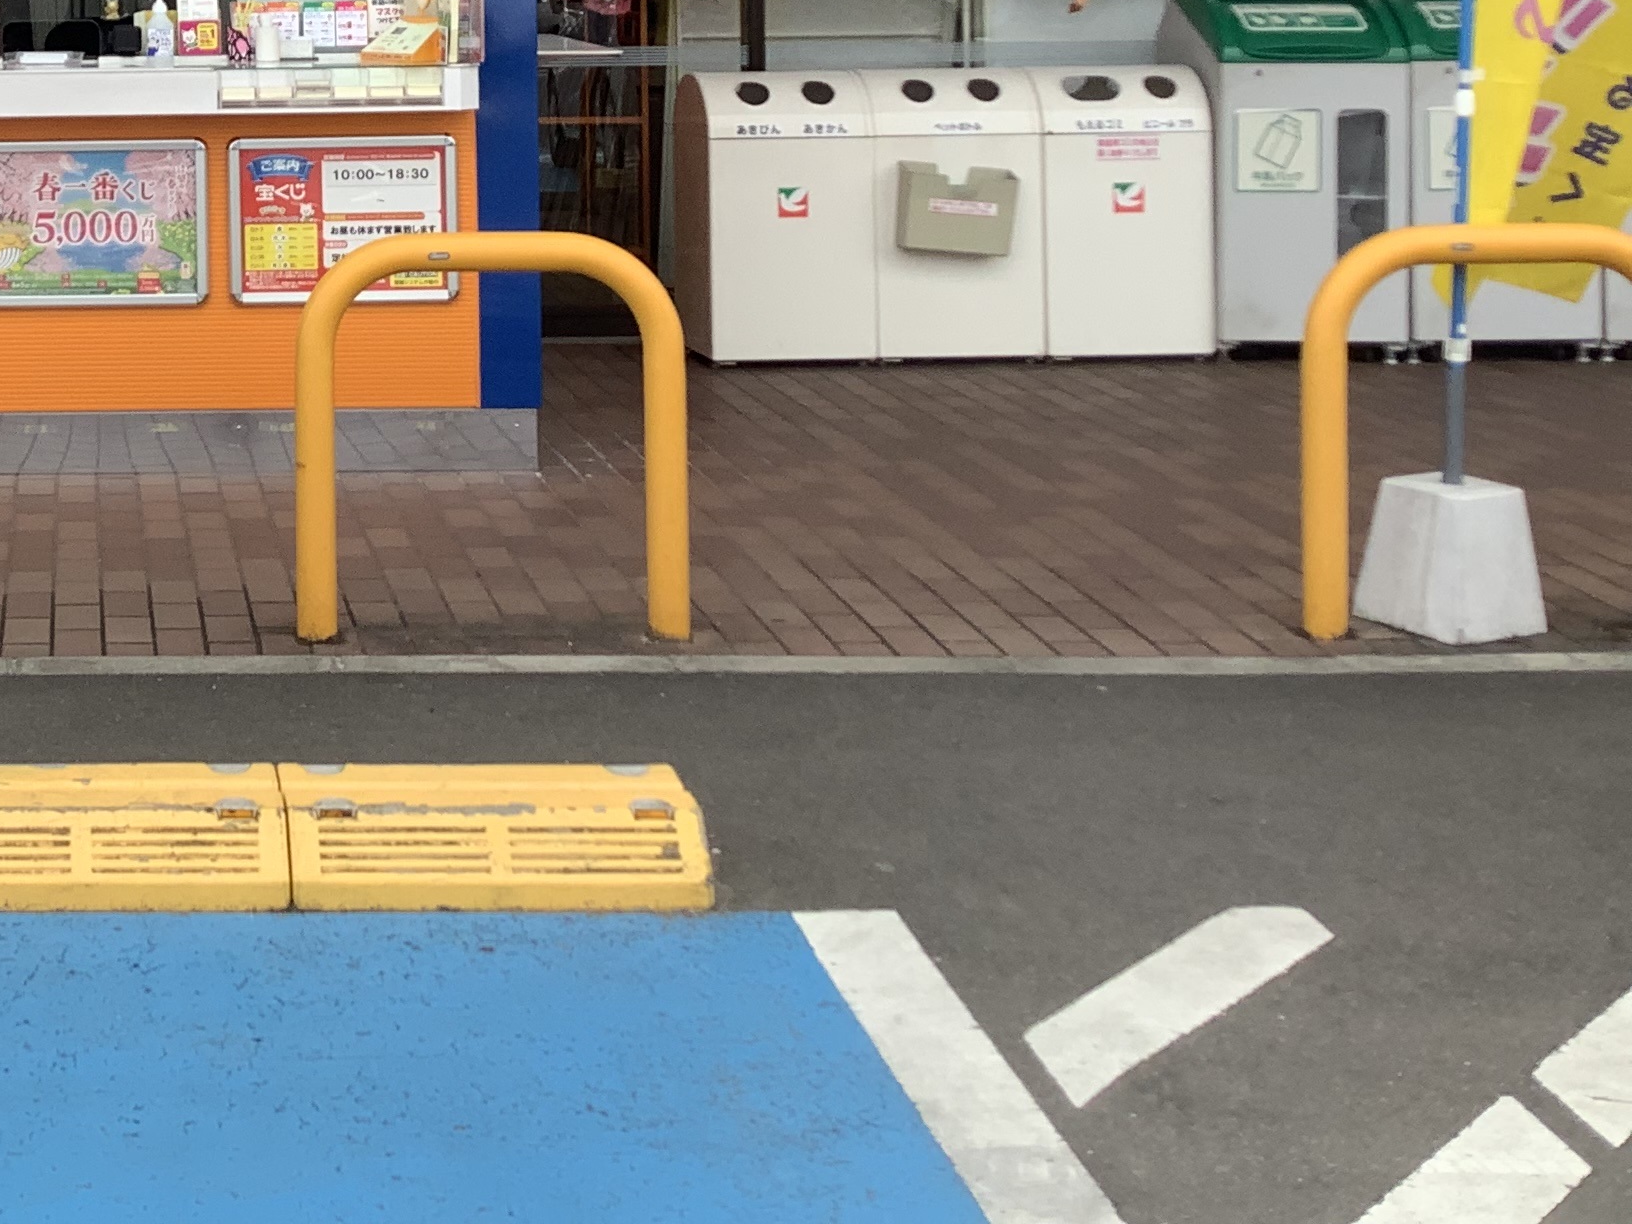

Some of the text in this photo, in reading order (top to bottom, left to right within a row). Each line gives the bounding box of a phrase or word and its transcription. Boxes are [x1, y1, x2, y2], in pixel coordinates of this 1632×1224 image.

[736, 124, 781, 135] あきびん
[803, 124, 848, 134] あきかん
[260, 159, 300, 172] ご案内
[33, 170, 155, 202] 春一番くじ
[255, 183, 306, 201] 宝くじ
